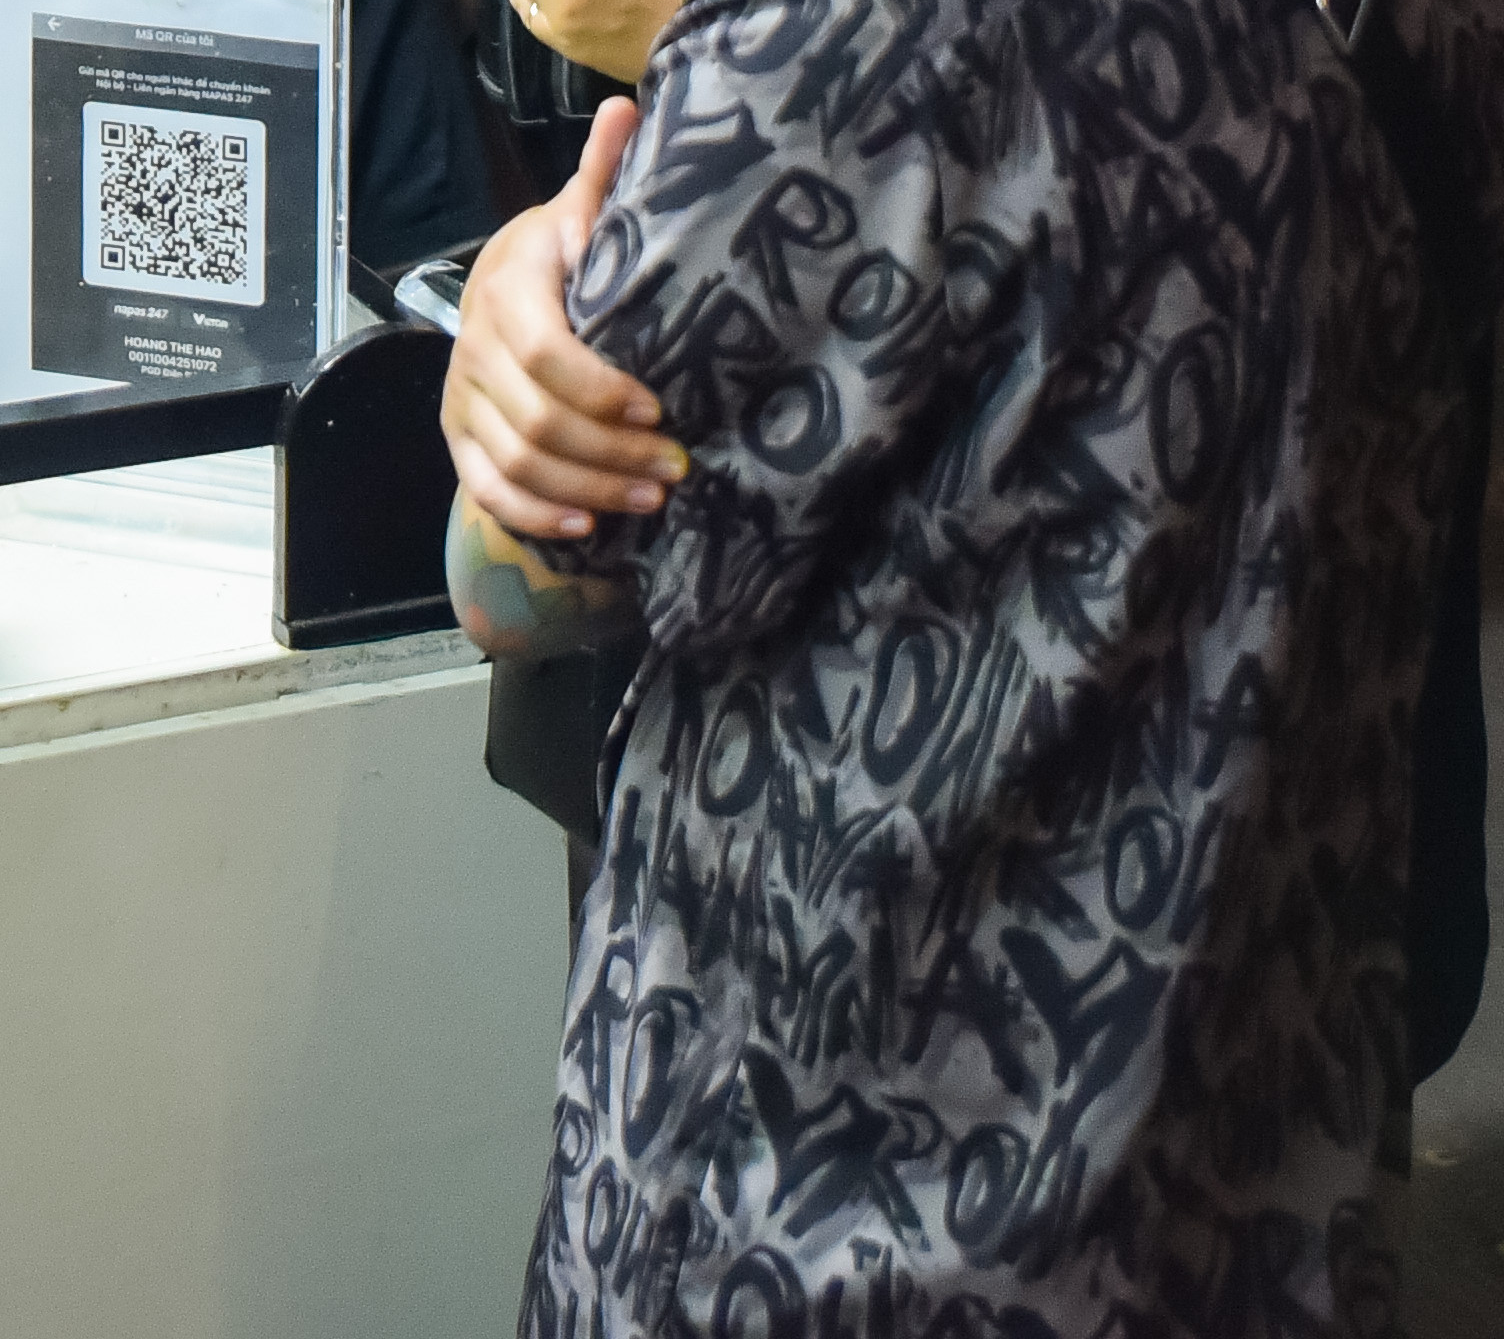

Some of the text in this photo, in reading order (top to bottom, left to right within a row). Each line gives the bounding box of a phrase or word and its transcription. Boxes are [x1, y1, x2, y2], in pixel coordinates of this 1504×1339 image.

[156, 30, 173, 44] QR
[202, 88, 234, 103] NAPAS
[235, 92, 253, 104] 247
[147, 306, 169, 319] 247
[124, 335, 222, 359] HOANG THE HAO
[128, 350, 218, 372] 0011004251072
